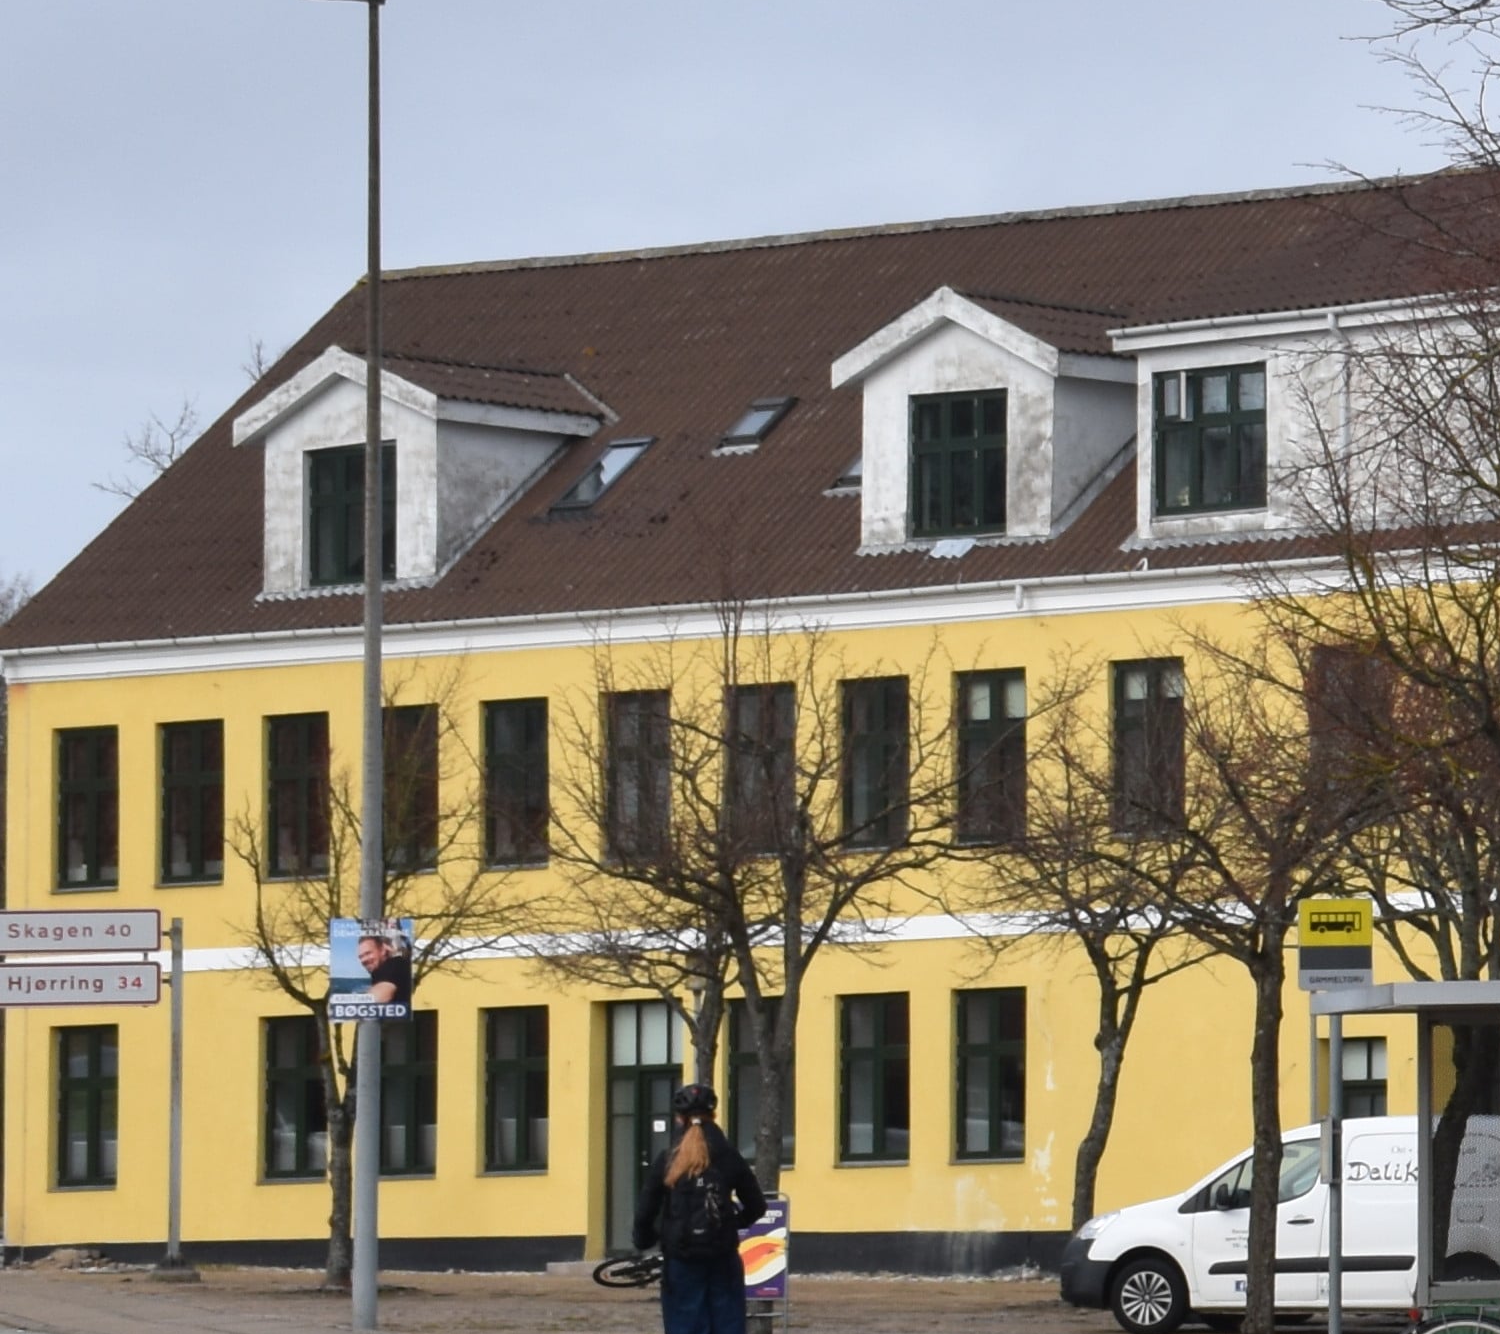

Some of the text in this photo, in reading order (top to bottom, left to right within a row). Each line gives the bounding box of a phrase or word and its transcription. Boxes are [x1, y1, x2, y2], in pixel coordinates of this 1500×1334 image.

[7, 923, 132, 941] Skagen 40
[7, 975, 143, 994] Hjørring 34
[334, 1004, 407, 1018] BØGSTED
